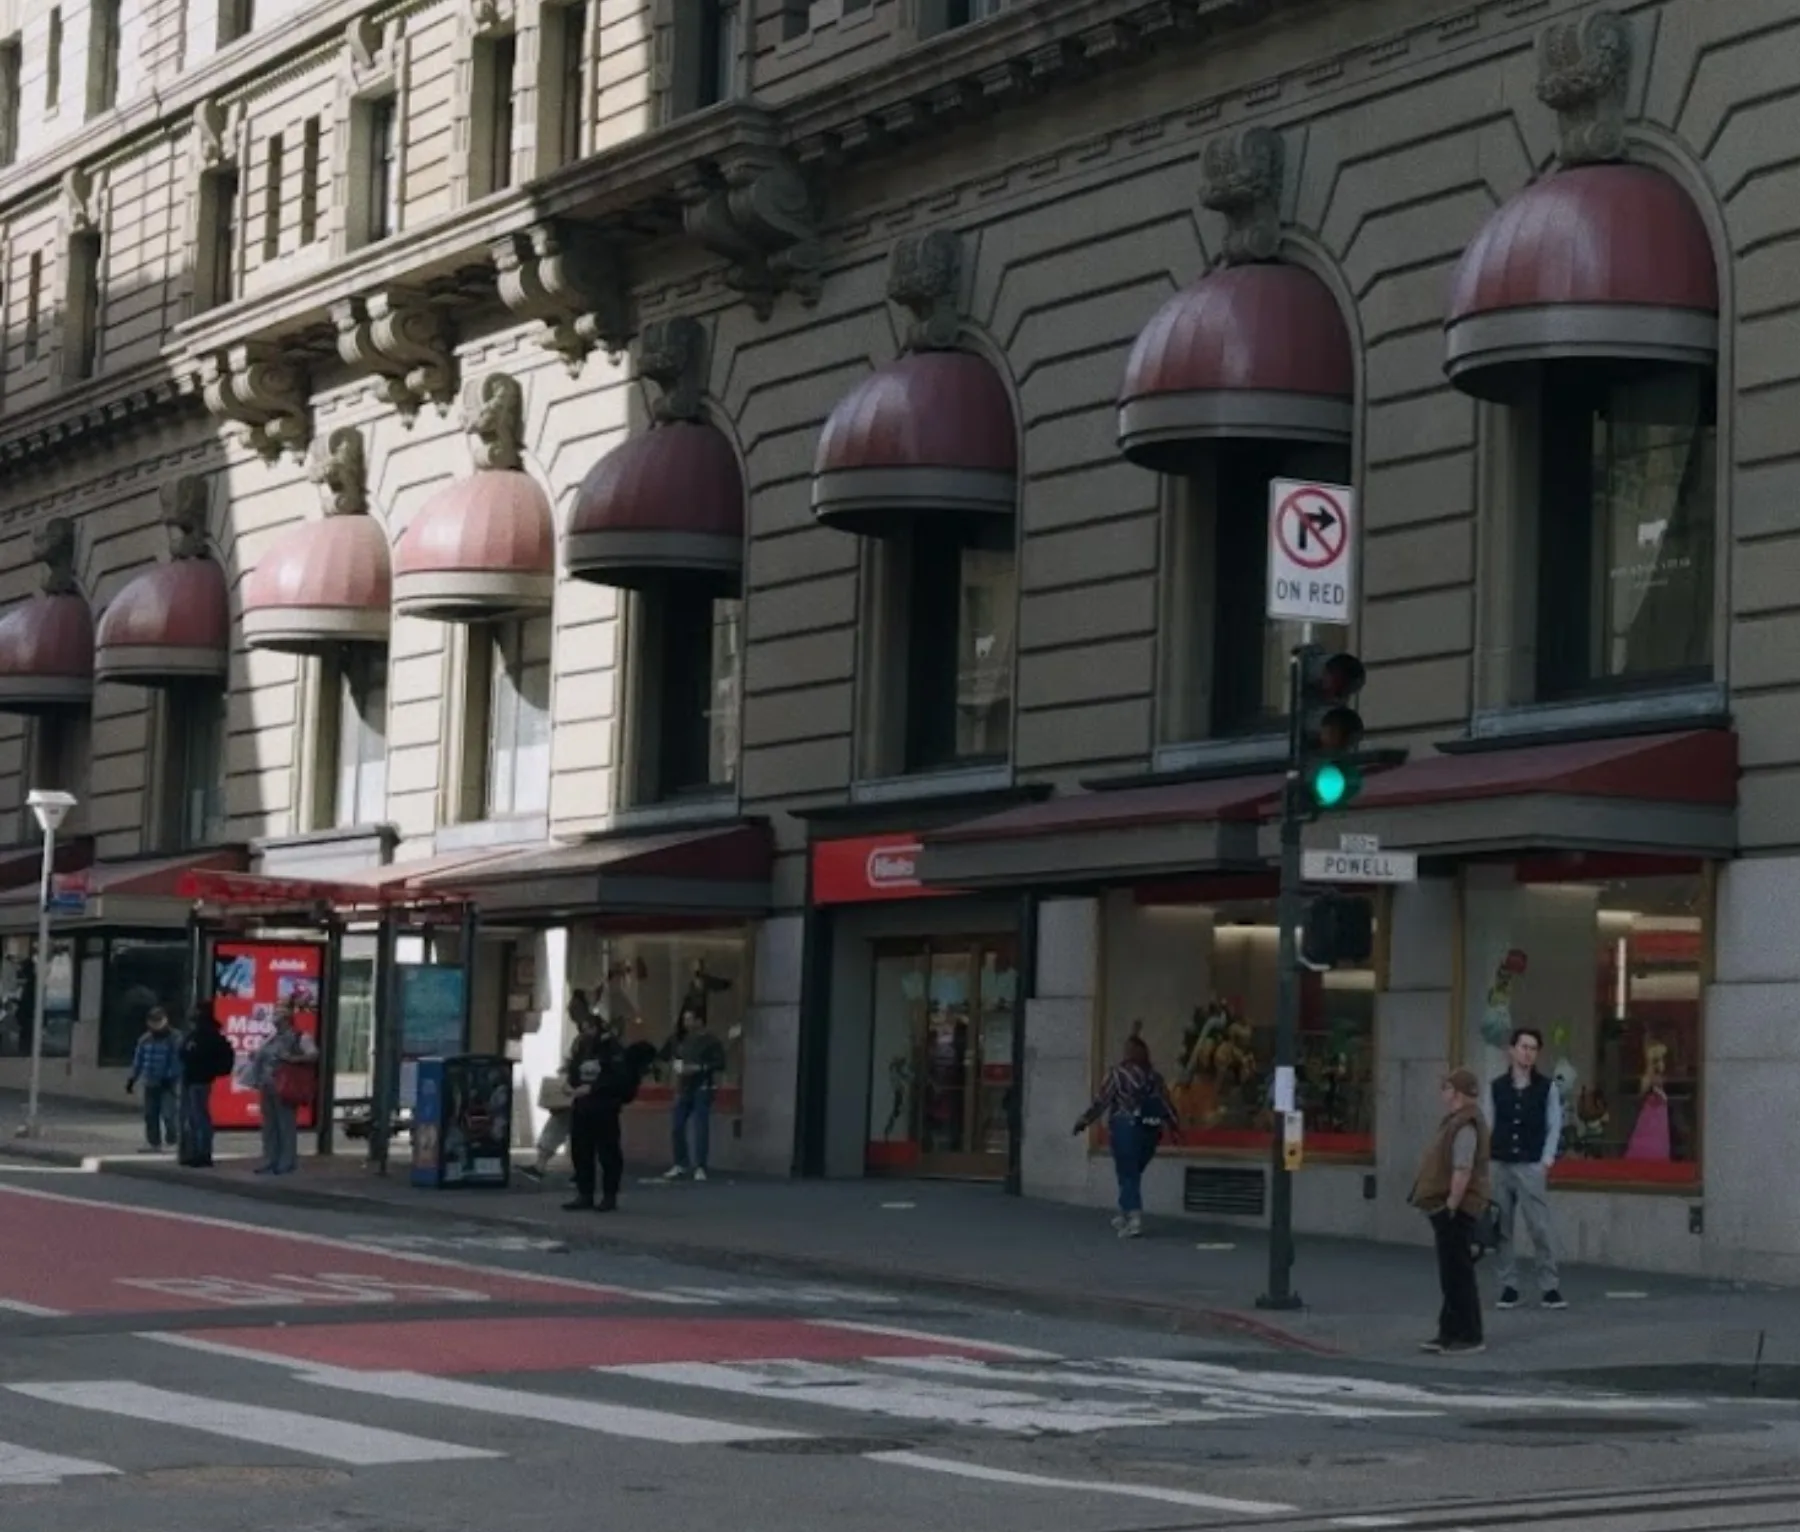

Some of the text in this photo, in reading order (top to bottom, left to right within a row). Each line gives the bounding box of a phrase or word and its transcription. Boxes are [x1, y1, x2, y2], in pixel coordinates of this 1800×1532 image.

[1276, 578, 1344, 605] ON RED
[1323, 855, 1394, 876] POWELL
[112, 1273, 491, 1305] BUS
